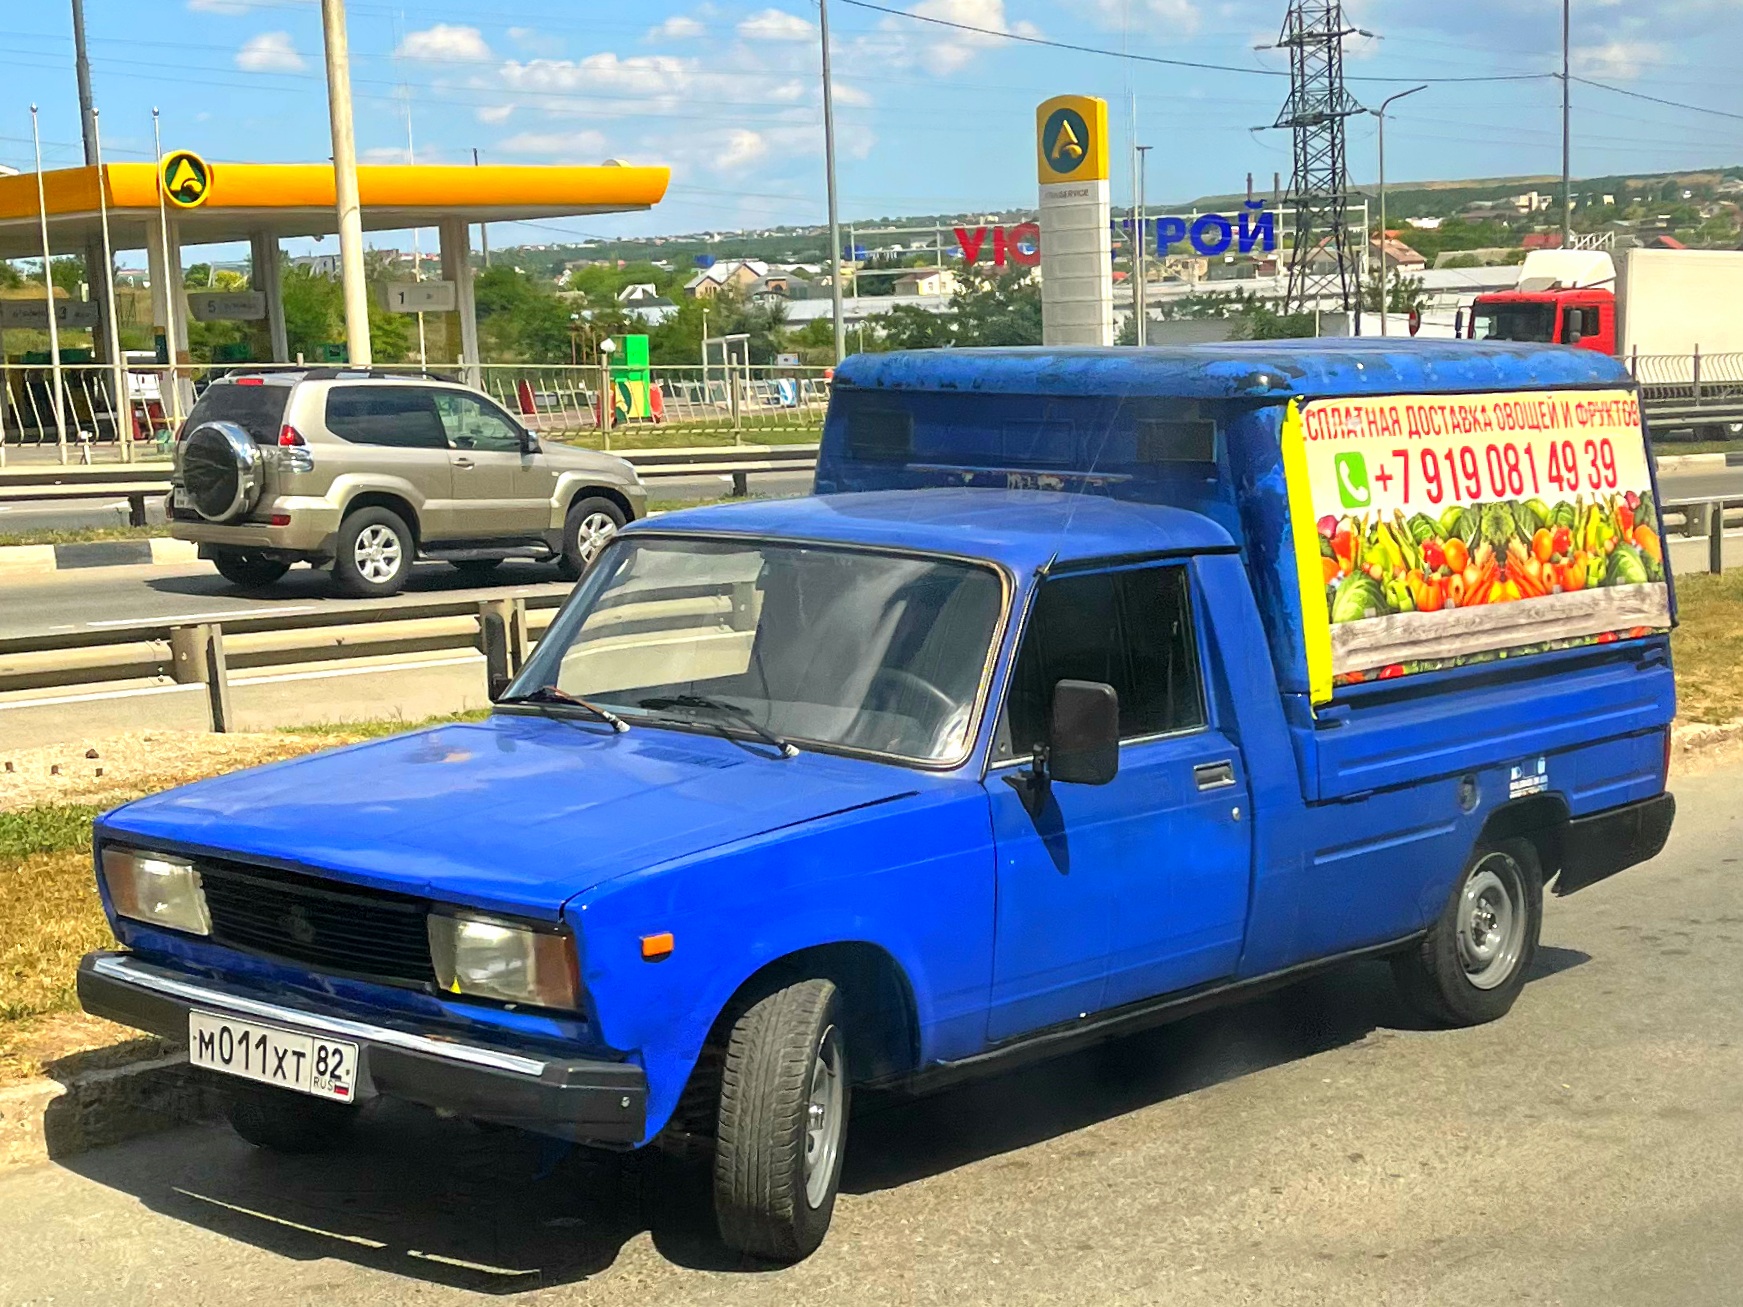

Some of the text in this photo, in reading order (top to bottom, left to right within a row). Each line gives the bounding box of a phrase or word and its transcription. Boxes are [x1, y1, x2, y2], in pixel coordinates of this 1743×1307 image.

[1110, 199, 1276, 258] ТРОЙ
[207, 299, 217, 313] 5
[1300, 396, 1640, 441] СПЛАТНАЯ ДОСТАВКА ОВОЩЕЙ И ФРУКТОВ
[1374, 437, 1617, 504] +7 919 081 49 39
[315, 1044, 344, 1081] 82
[313, 1077, 334, 1091] RUS
